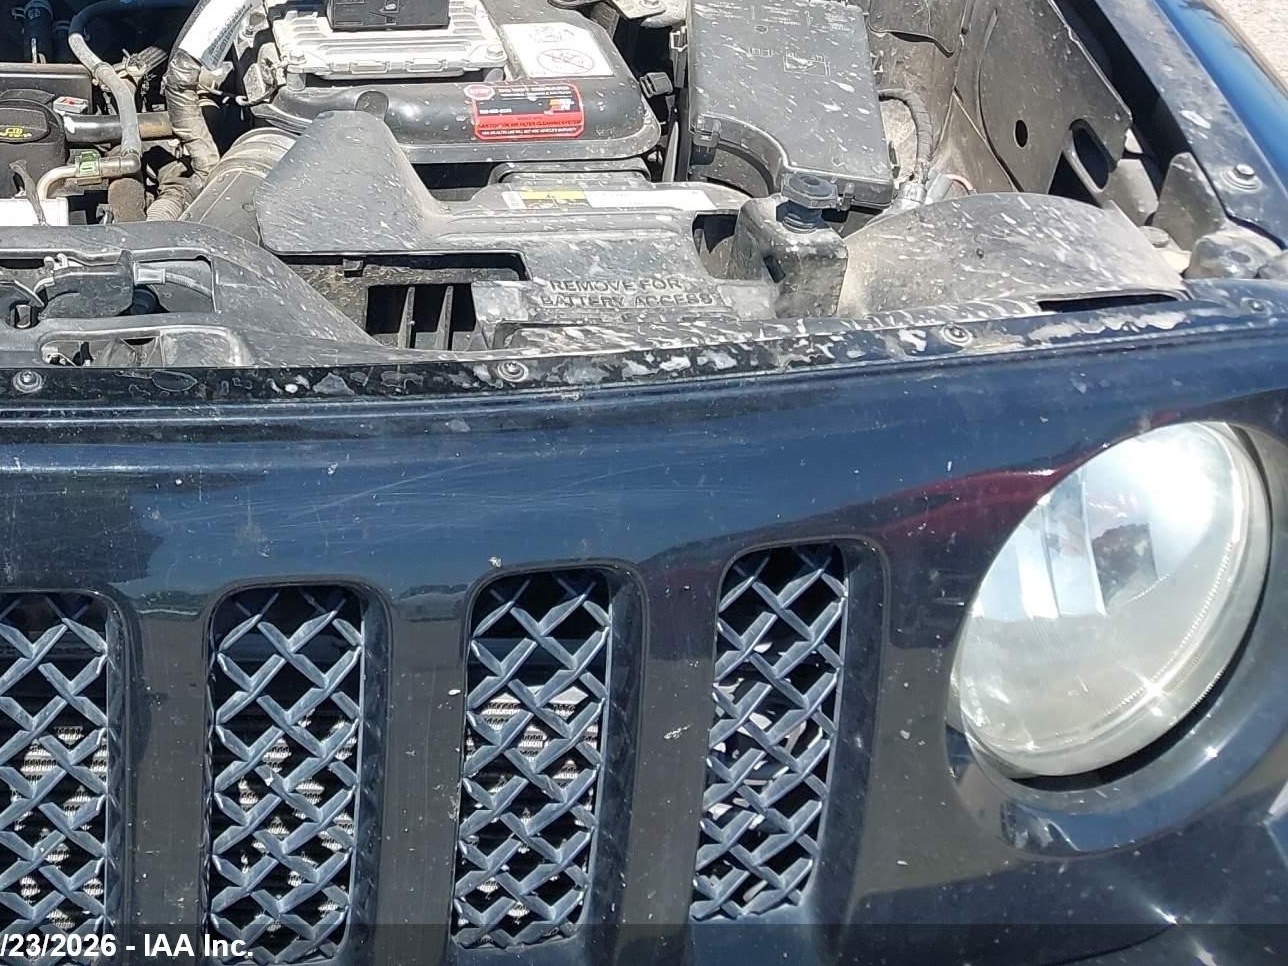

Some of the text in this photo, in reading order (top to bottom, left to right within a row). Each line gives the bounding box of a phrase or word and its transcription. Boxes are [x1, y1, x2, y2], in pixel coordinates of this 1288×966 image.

[549, 278, 683, 292] REMOVE FOR
[540, 292, 713, 307] BATTERY ACCESS
